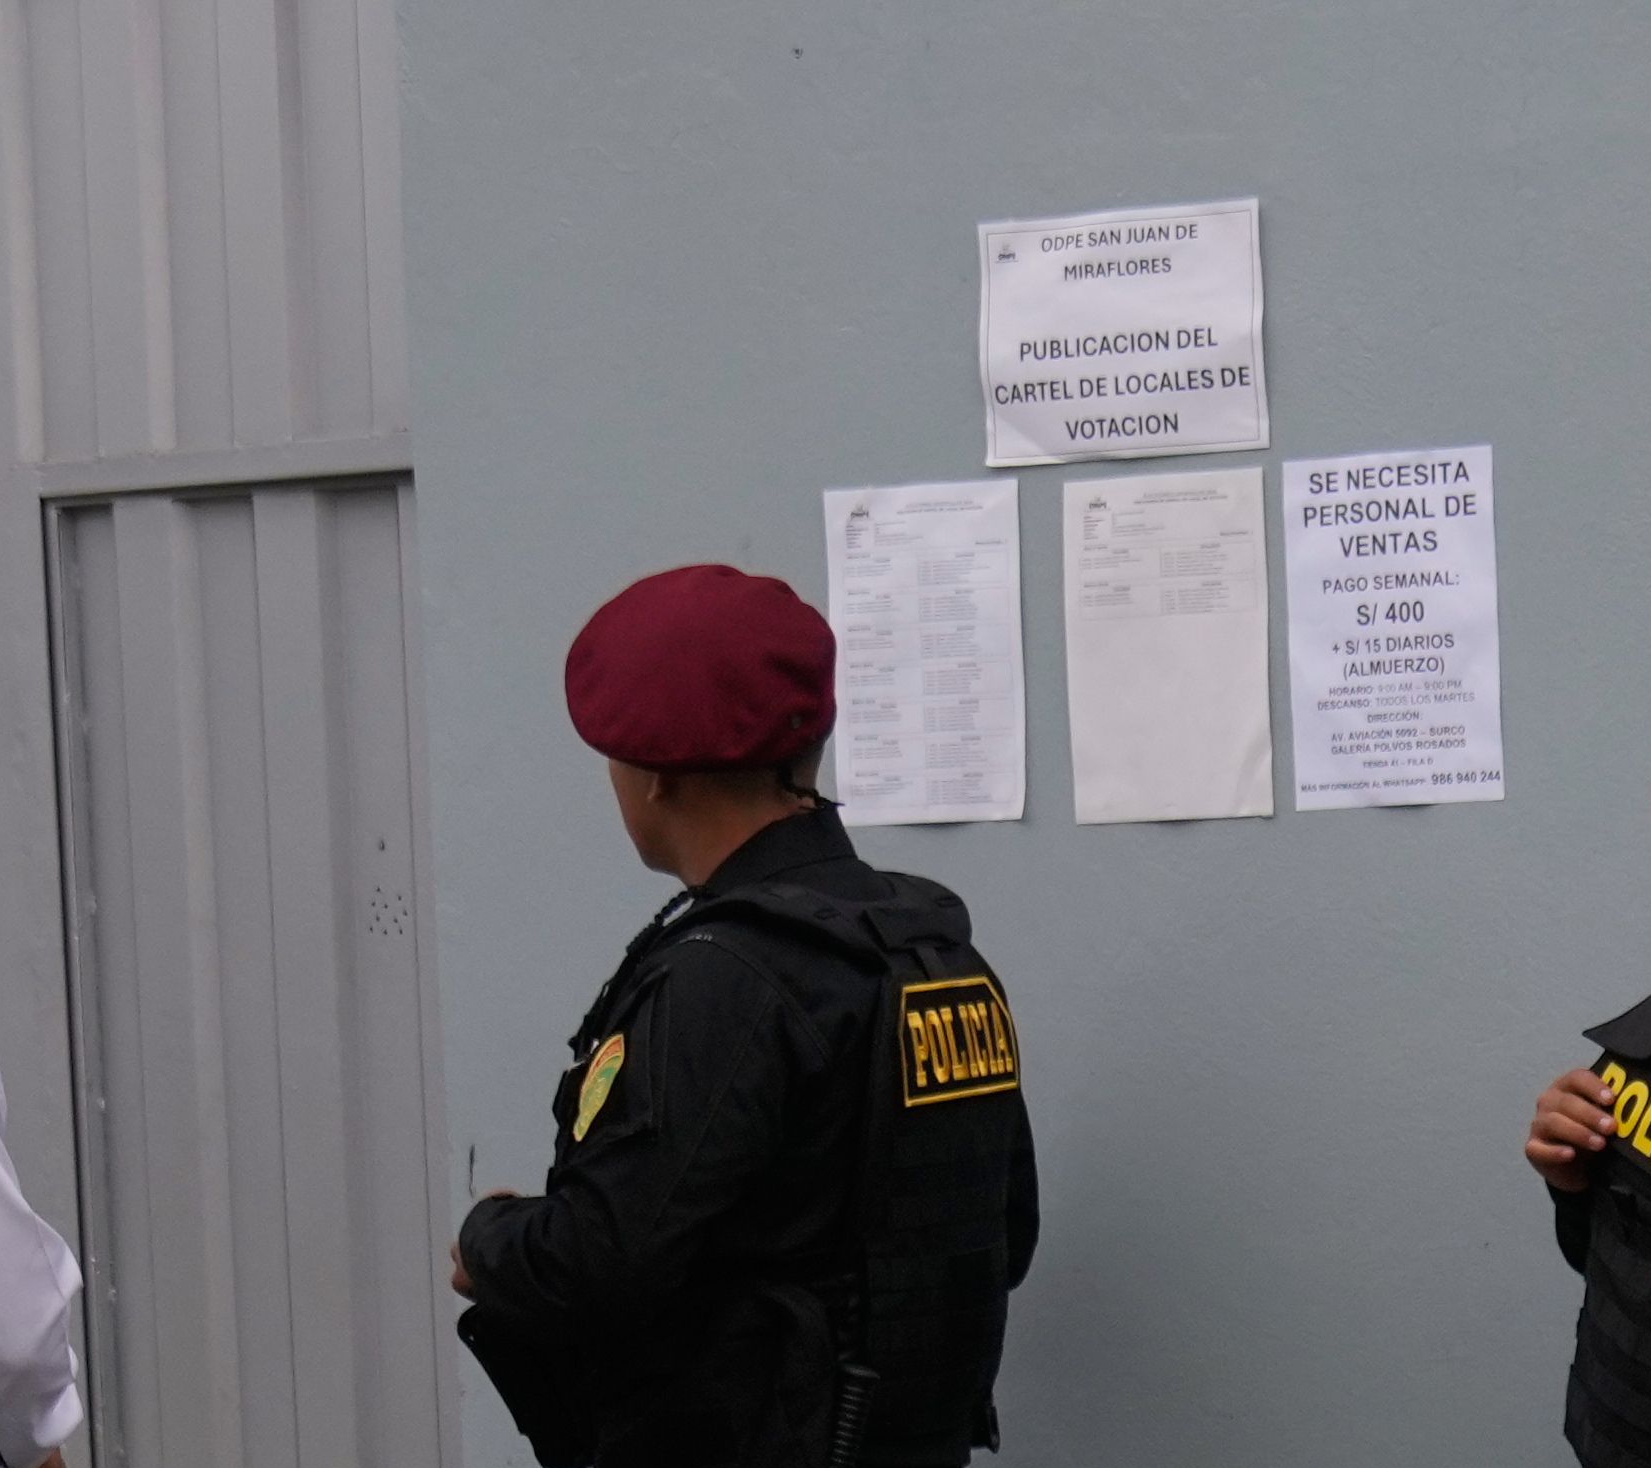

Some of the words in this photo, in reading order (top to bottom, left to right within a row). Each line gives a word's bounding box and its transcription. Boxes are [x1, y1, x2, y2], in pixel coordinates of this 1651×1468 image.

[1041, 233, 1083, 253] ODPE
[1088, 229, 1122, 248] SAN
[1126, 225, 1170, 245] JUAN
[1176, 224, 1198, 240] DE
[1064, 258, 1171, 281] MIRAFLORES
[1020, 331, 1170, 361] PUBLICACION
[1177, 327, 1218, 349] DEL
[995, 381, 1073, 405] CARTEL
[1080, 377, 1108, 398] DE
[1115, 370, 1215, 396] LOCALES
[1221, 367, 1251, 388] DE
[1065, 413, 1179, 440] VOTACION
[1309, 472, 1339, 494] SE
[1347, 461, 1470, 491] NECESITA
[1303, 498, 1435, 528] PERSONAL
[1445, 494, 1477, 517] DE
[1340, 530, 1438, 558] VENTAS
[1323, 577, 1368, 594] PAGO
[1373, 571, 1460, 590] SEMANAL:
[1357, 604, 1378, 626] S/
[1385, 601, 1425, 624] 400
[1345, 640, 1360, 655] S/
[1365, 638, 1381, 653] 15
[1386, 634, 1455, 652] DIARIOS
[1343, 657, 1445, 680] (ALMUERZO)
[1399, 681, 1413, 692] AM
[1447, 680, 1462, 690] PM
[1410, 695, 1432, 705] LOS
[1434, 692, 1475, 704] MARTES
[1429, 726, 1466, 737] SURCO
[1374, 741, 1413, 752] POLVOS
[1416, 739, 1466, 750] ROSADOS
[1480, 770, 1501, 782] 244
[907, 1000, 1012, 1087] POLICIA
